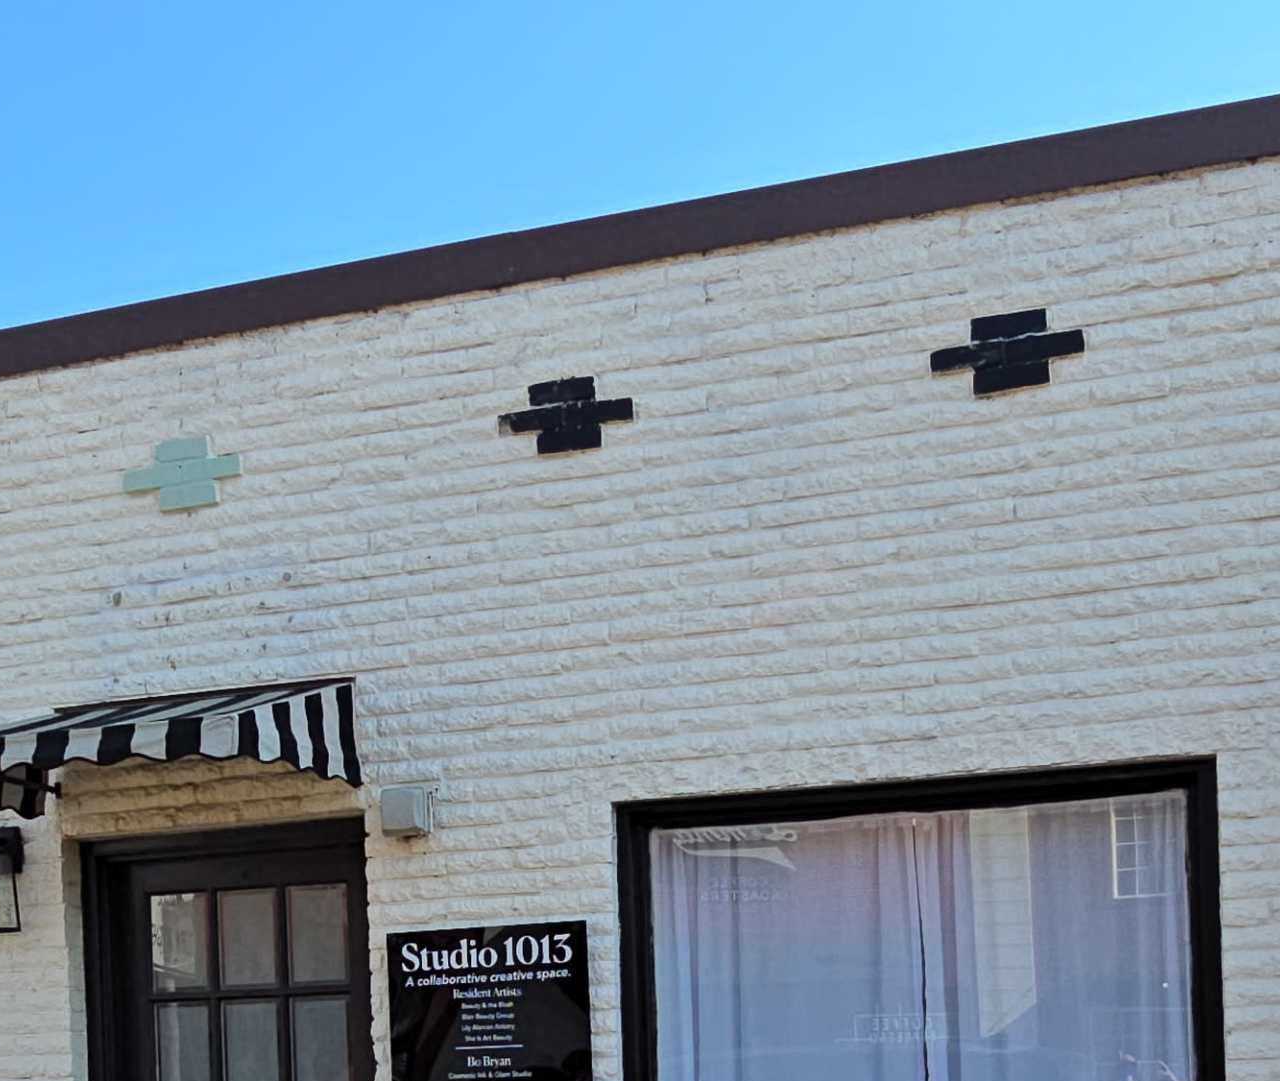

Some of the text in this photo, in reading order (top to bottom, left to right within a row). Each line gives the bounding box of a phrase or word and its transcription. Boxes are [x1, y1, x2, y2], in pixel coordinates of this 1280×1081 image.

[401, 933, 573, 972] Studio 1013
[405, 968, 572, 988] A collaborative creative space.
[453, 987, 522, 1000] Resident Artists
[467, 1055, 512, 1069] Bo Bryan
